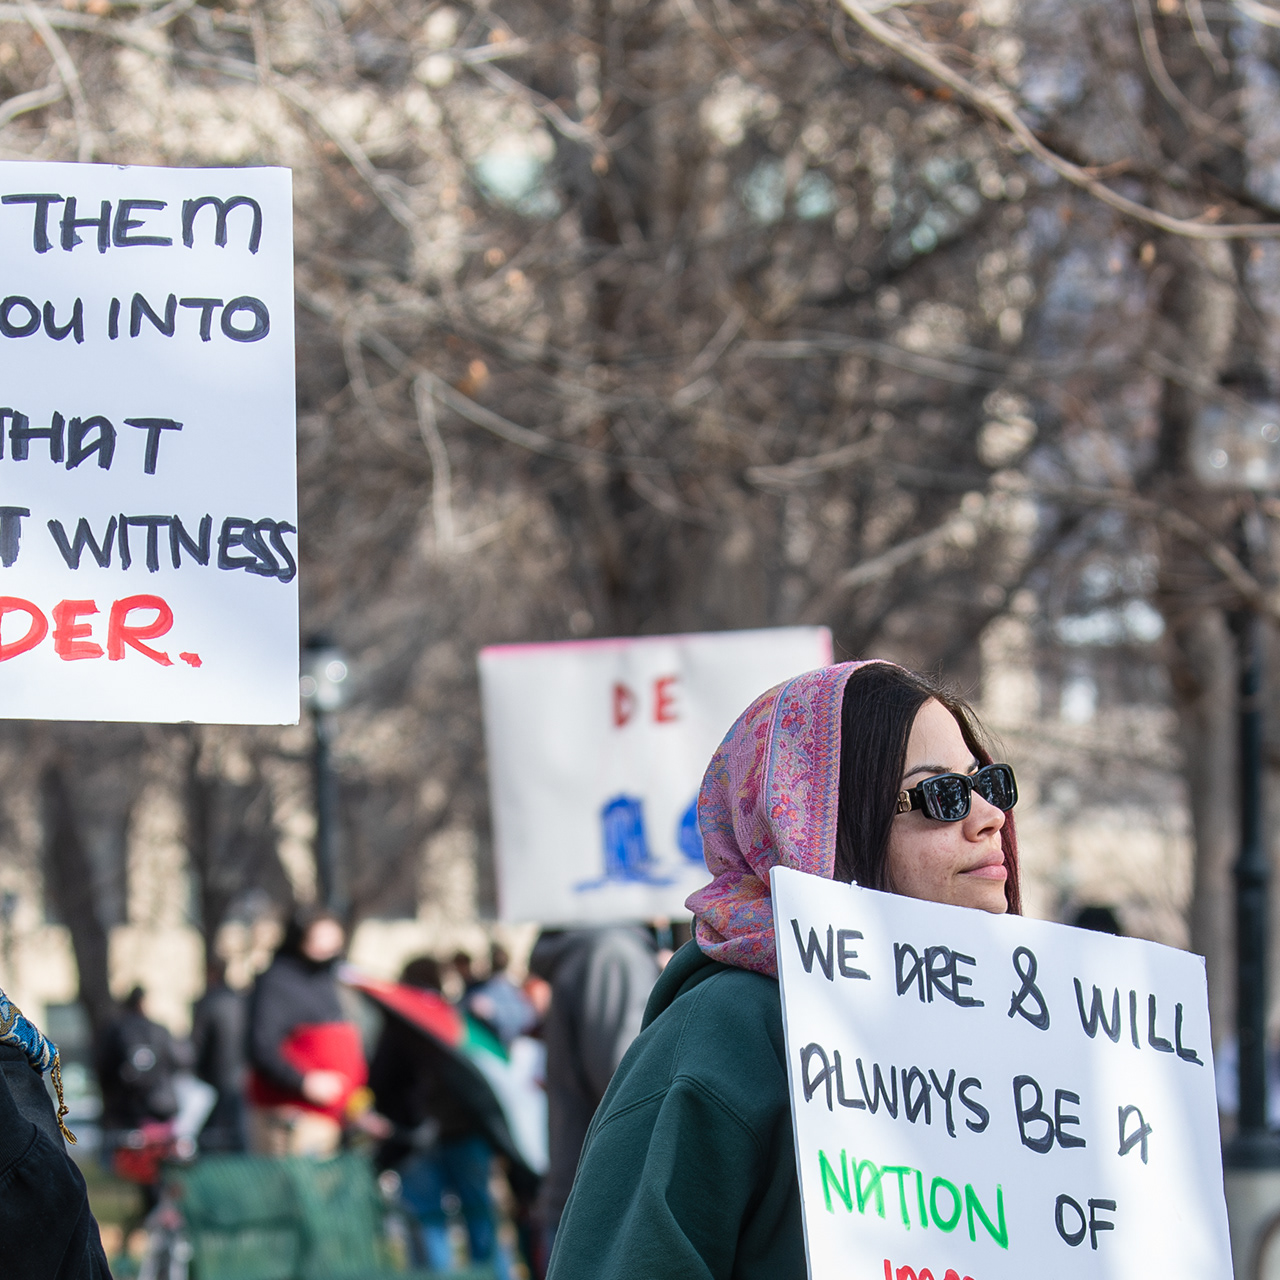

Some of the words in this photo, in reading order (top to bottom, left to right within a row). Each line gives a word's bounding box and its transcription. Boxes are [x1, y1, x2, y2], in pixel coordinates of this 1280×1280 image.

[0, 192, 264, 256] THEM
[107, 292, 271, 344] INTO
[46, 512, 298, 584] WITNESS
[789, 918, 871, 982] WE
[893, 941, 985, 1008] ARE
[1007, 945, 1051, 1031] &
[1073, 976, 1205, 1067] WILL
[799, 1042, 990, 1139] ALWAYS
[1012, 1074, 1087, 1155] BE
[1117, 1105, 1153, 1165] A
[817, 1148, 1010, 1252] NATION
[1054, 1193, 1117, 1251] OF
